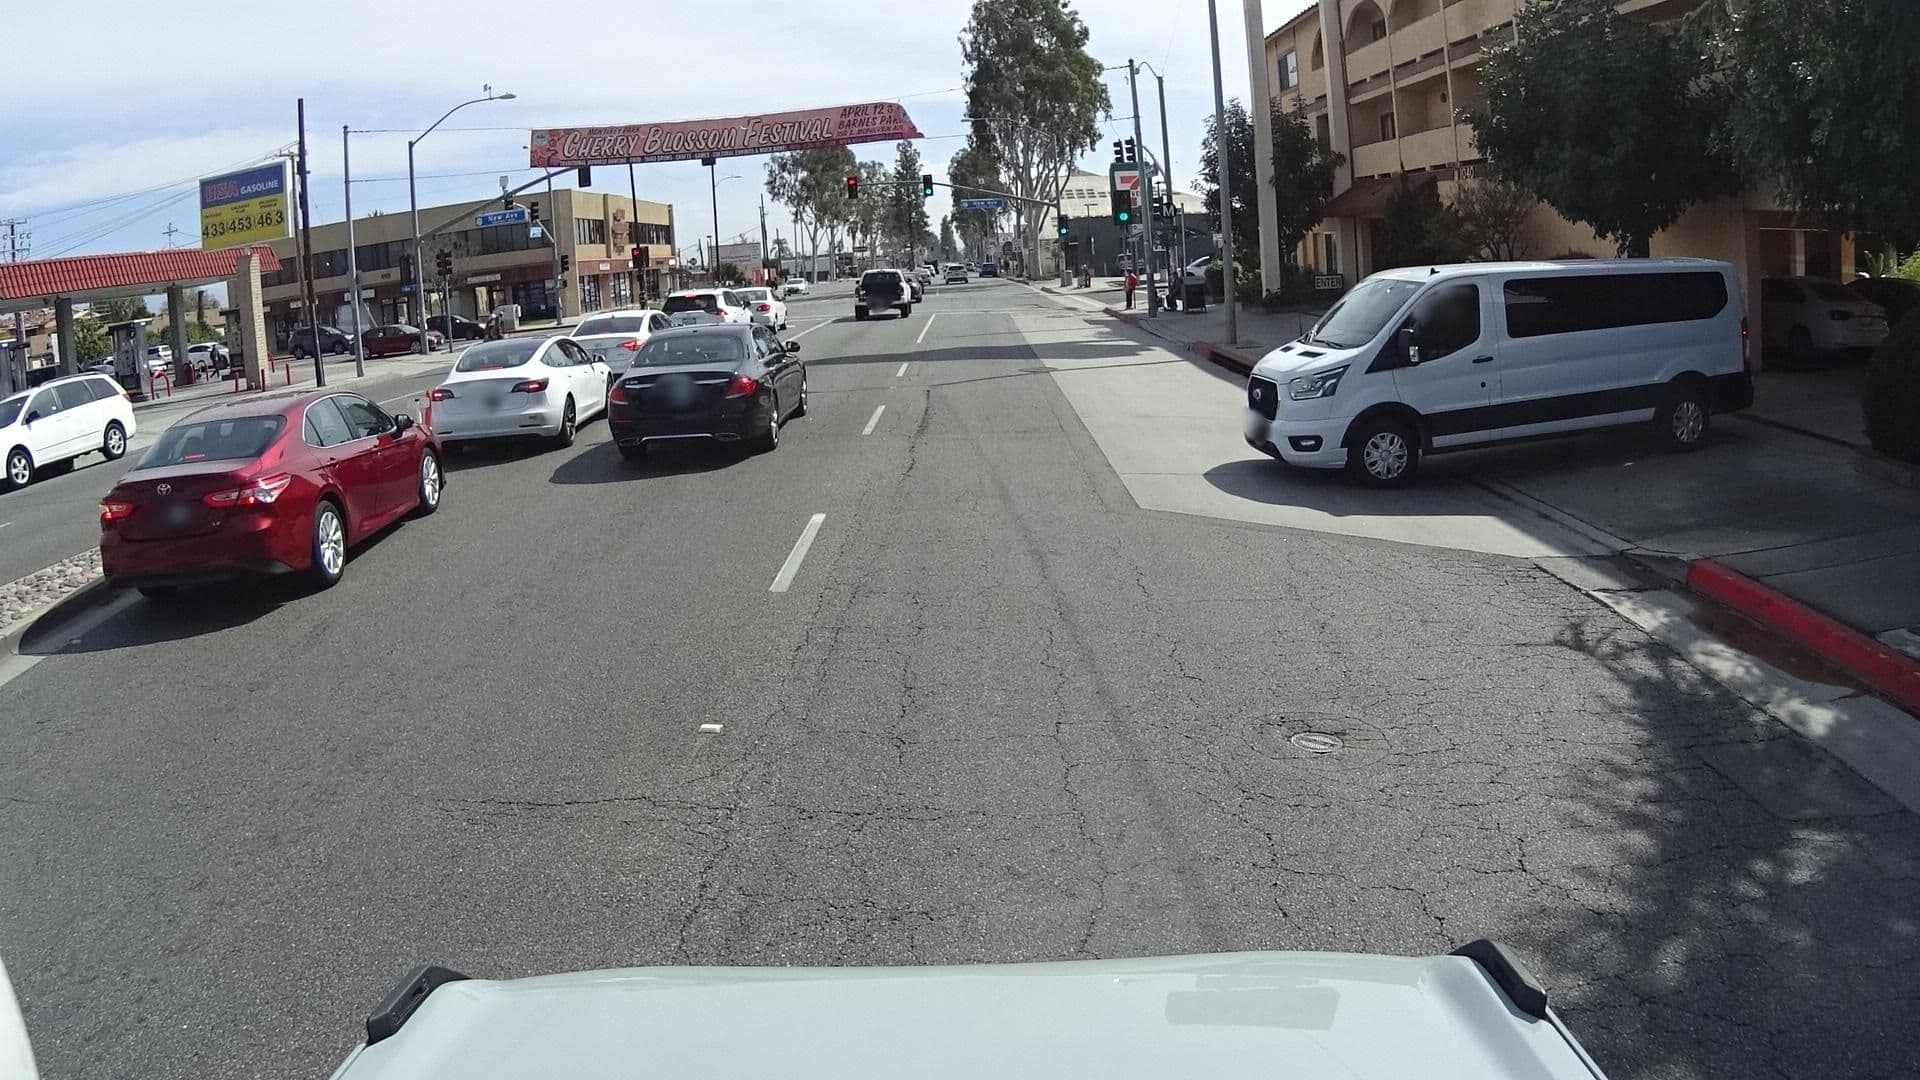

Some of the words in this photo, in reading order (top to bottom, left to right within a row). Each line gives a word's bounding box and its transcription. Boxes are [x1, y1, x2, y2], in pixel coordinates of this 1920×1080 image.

[840, 104, 869, 118] APRIL
[873, 104, 884, 115] 12
[838, 116, 877, 129] BARNES
[562, 131, 639, 158] CHERRY
[644, 126, 736, 155] BLOSSOM
[742, 118, 833, 147] FESTIVAL
[206, 180, 239, 203] USA
[240, 179, 279, 194] GASOLINE
[202, 222, 226, 239] 433
[229, 216, 252, 232] 453
[1316, 277, 1341, 288] ENTER
